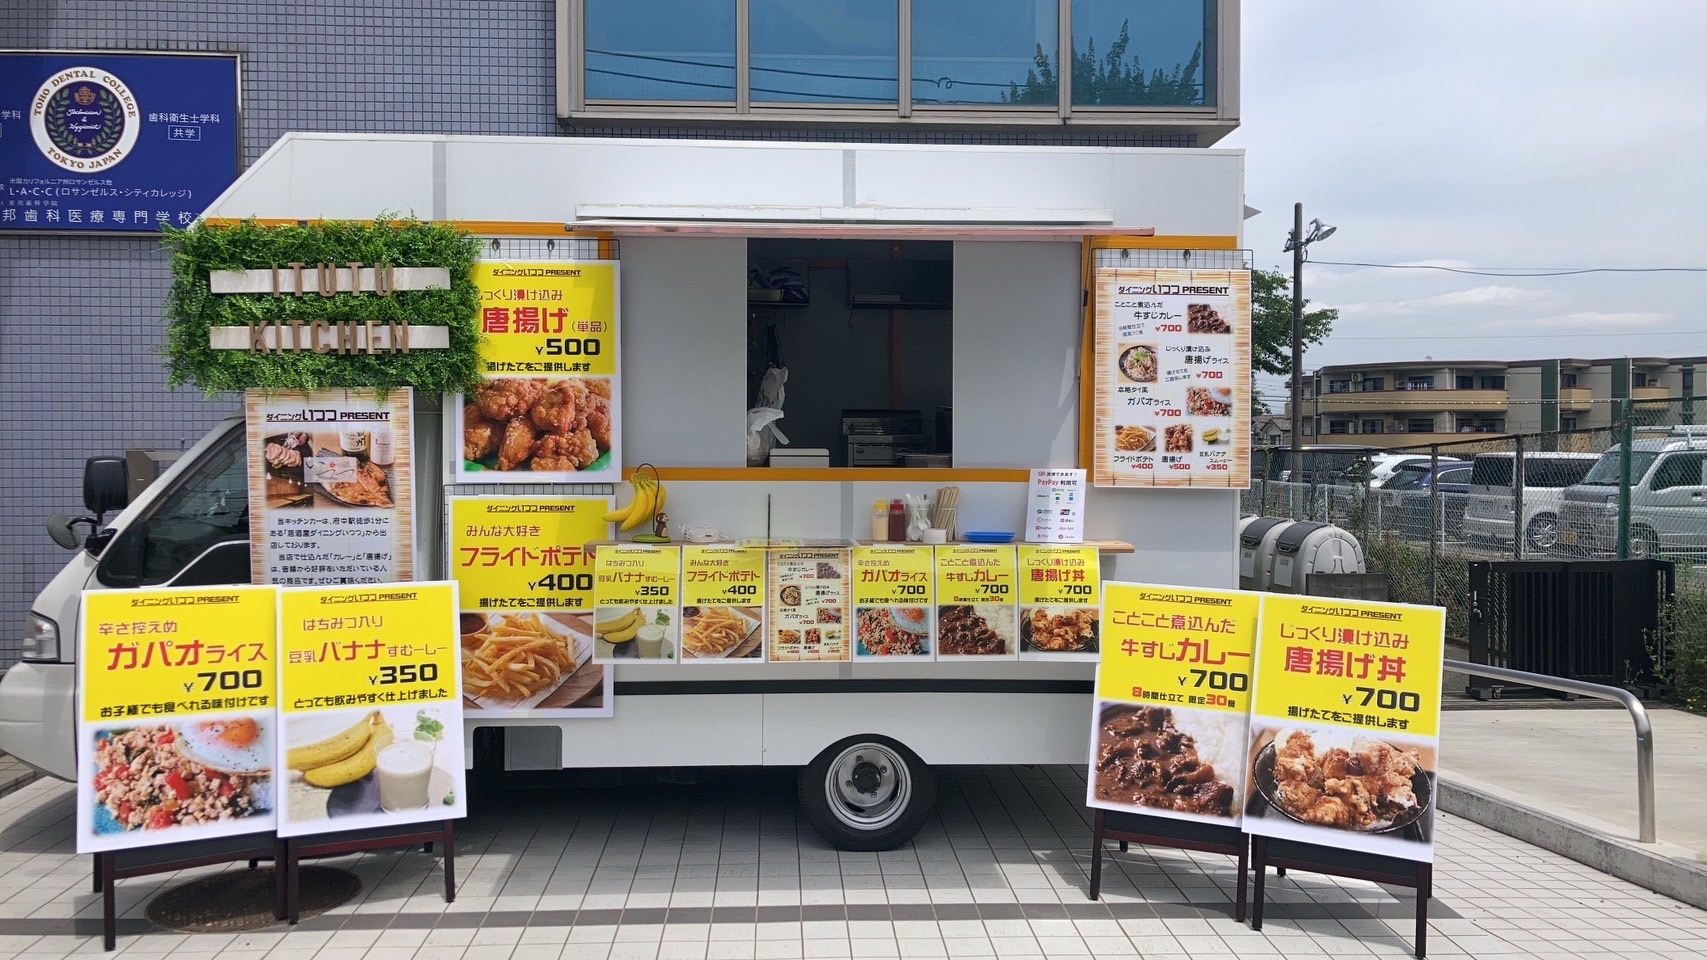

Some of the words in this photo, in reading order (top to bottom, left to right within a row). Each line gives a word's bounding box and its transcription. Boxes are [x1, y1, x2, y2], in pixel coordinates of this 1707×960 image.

[34, 88, 50, 117] TOHO
[52, 70, 96, 87] DENTAL
[103, 76, 136, 118] COLLEGE
[148, 113, 220, 124] 歯科衛生士学科
[68, 123, 102, 133] Hygienist
[173, 128, 196, 138] 共学
[47, 147, 84, 168] TOKYO
[89, 149, 122, 168] JAPAN
[272, 262, 394, 298] ITUTU
[479, 290, 562, 300] っくり漬け込み
[1134, 312, 1182, 320] 牛すじカレー
[249, 320, 410, 355] KITCHEN
[536, 339, 600, 355] ¥500
[487, 362, 591, 371] 揚げたてをご提供します
[1184, 356, 1229, 364] 唐揚げライス
[1128, 397, 1171, 406] ガパオライス
[466, 525, 541, 537] みんな大好き
[270, 541, 320, 549] 店しております。
[528, 574, 592, 590] ¥400
[687, 570, 760, 582] フライドポテト
[862, 569, 928, 582] ガパオライス
[946, 569, 1009, 582] 牛すじカレー
[1031, 569, 1085, 582] 唐揚げ丼
[635, 586, 669, 596] ¥350
[722, 585, 756, 594] ¥400
[892, 585, 925, 594] ¥700
[975, 585, 1009, 594] ¥700
[1058, 585, 1092, 594] ¥700
[479, 598, 583, 607] 揚げたてをご提供します
[1194, 597, 1232, 605] PRESENT
[1361, 610, 1402, 620] PRESENT
[98, 621, 177, 635] 辛さ控えめ
[303, 616, 383, 631] はちみつ入り
[1113, 610, 1236, 634] ことこと煮込んだ
[1280, 623, 1410, 649] じっくり漬け込み
[107, 639, 268, 671] ガパオライス
[1121, 637, 1250, 666] 牛すじカレー
[1284, 646, 1406, 683] 唐揚げ丼
[369, 663, 438, 685] ¥350
[1178, 669, 1248, 692] ¥700
[184, 669, 262, 693] ¥700
[294, 688, 448, 708] とっても飲みやすく仕上げました
[1132, 686, 1183, 703] 8時間仕立て
[1342, 686, 1420, 712] ¥700
[101, 696, 269, 717] お子様でも食べれる味付けです
[1288, 706, 1410, 729] 揚げたてをご提供します
